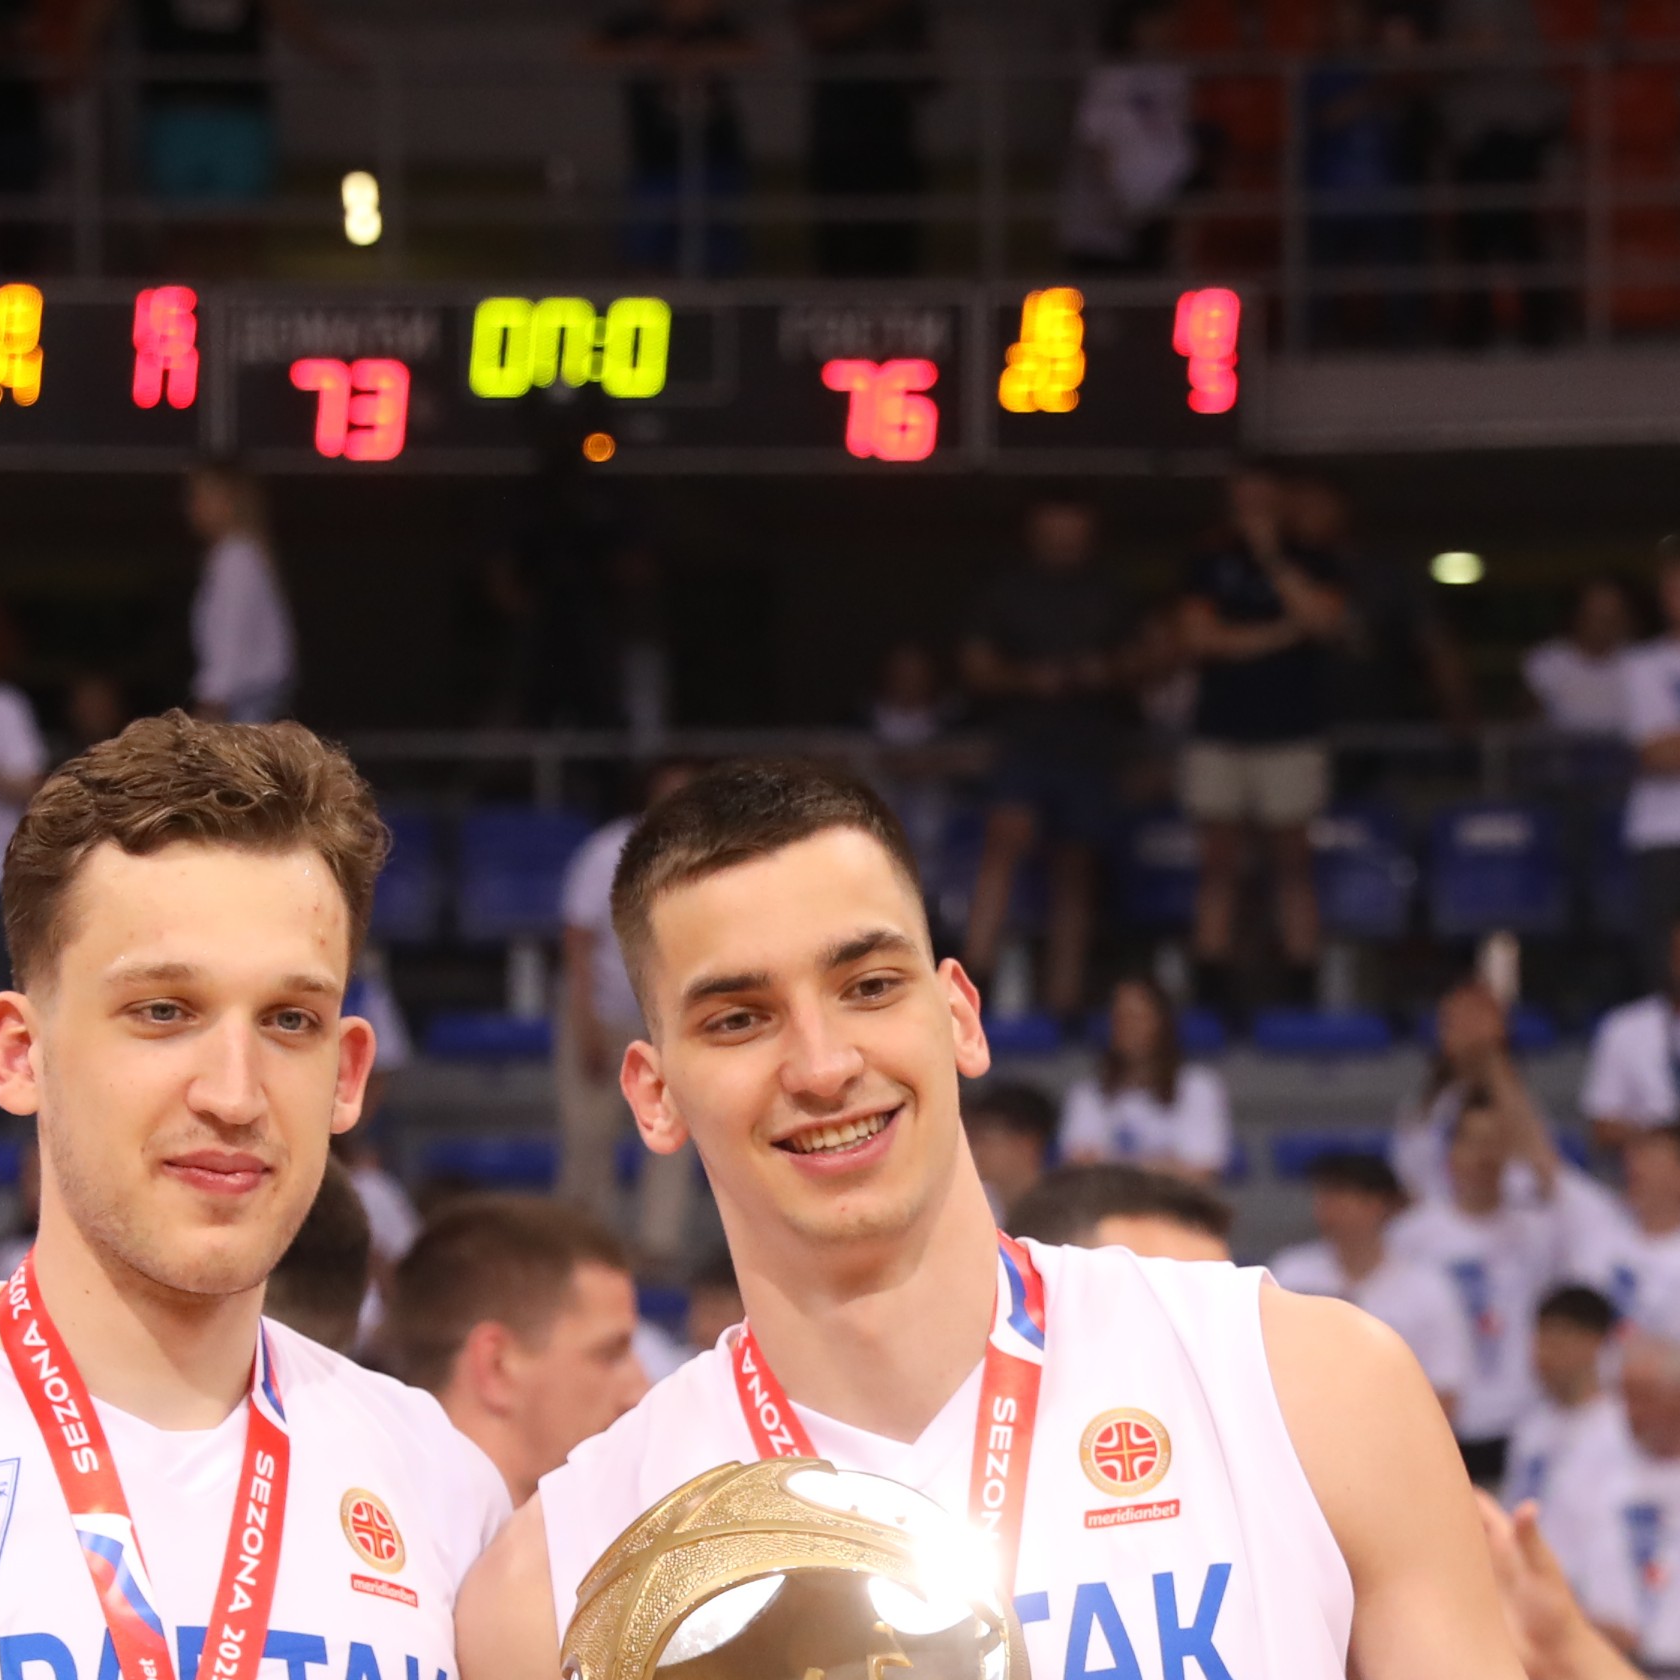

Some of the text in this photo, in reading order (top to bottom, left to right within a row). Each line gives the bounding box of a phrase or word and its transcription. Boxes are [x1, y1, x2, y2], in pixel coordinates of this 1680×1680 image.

[290, 357, 410, 461] 73
[822, 358, 939, 461] 76
[22, 1319, 99, 1474] SEZONA
[741, 1347, 801, 1457] ZONA
[228, 1450, 276, 1613] SEZONA
[1087, 1503, 1178, 1528] meridianbet
